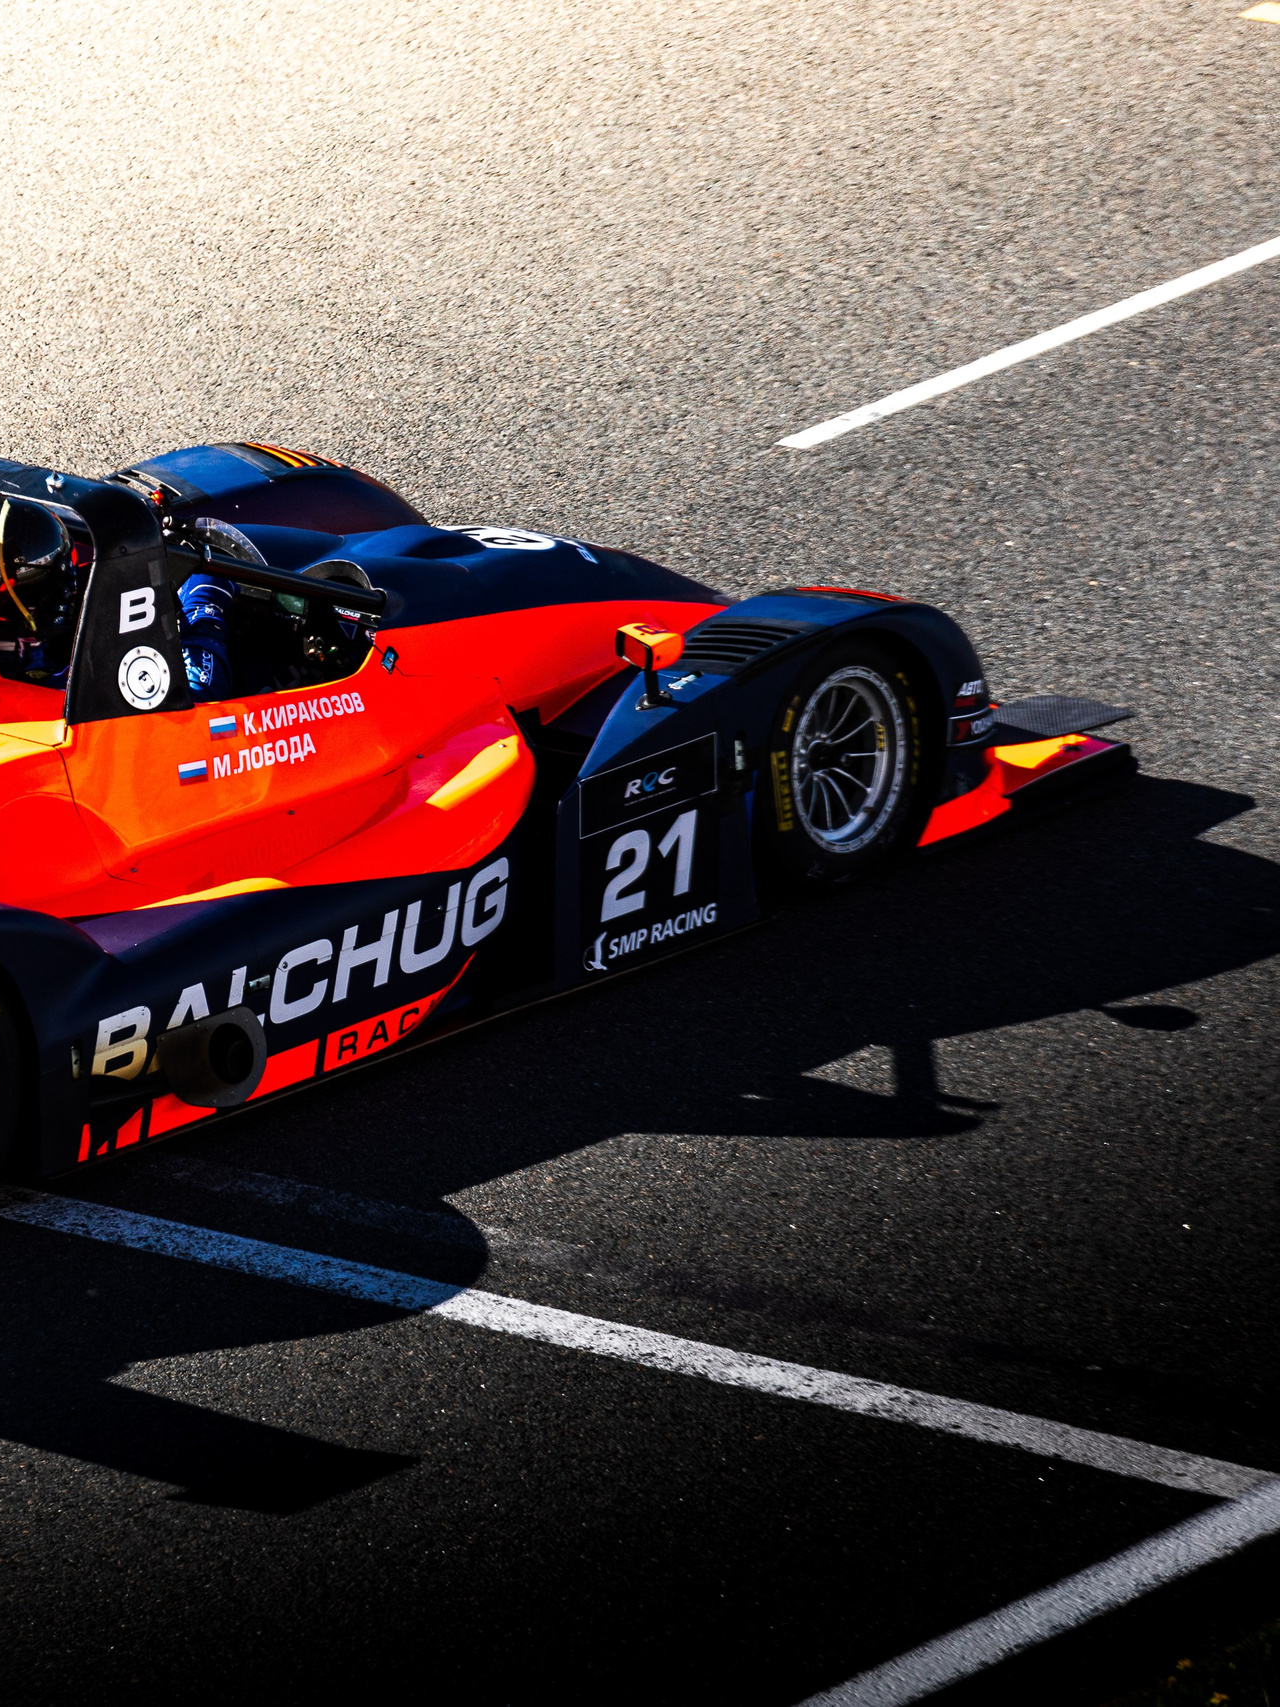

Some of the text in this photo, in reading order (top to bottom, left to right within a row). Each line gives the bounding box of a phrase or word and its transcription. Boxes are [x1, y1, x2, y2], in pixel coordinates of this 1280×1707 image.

[119, 586, 156, 634] B
[243, 692, 365, 736] К.КИРАКОЗОВ
[213, 733, 317, 780] М.ЛОБОДА
[600, 808, 698, 923] 21
[608, 903, 718, 959] SMP RACING
[336, 998, 437, 1061] RAC
